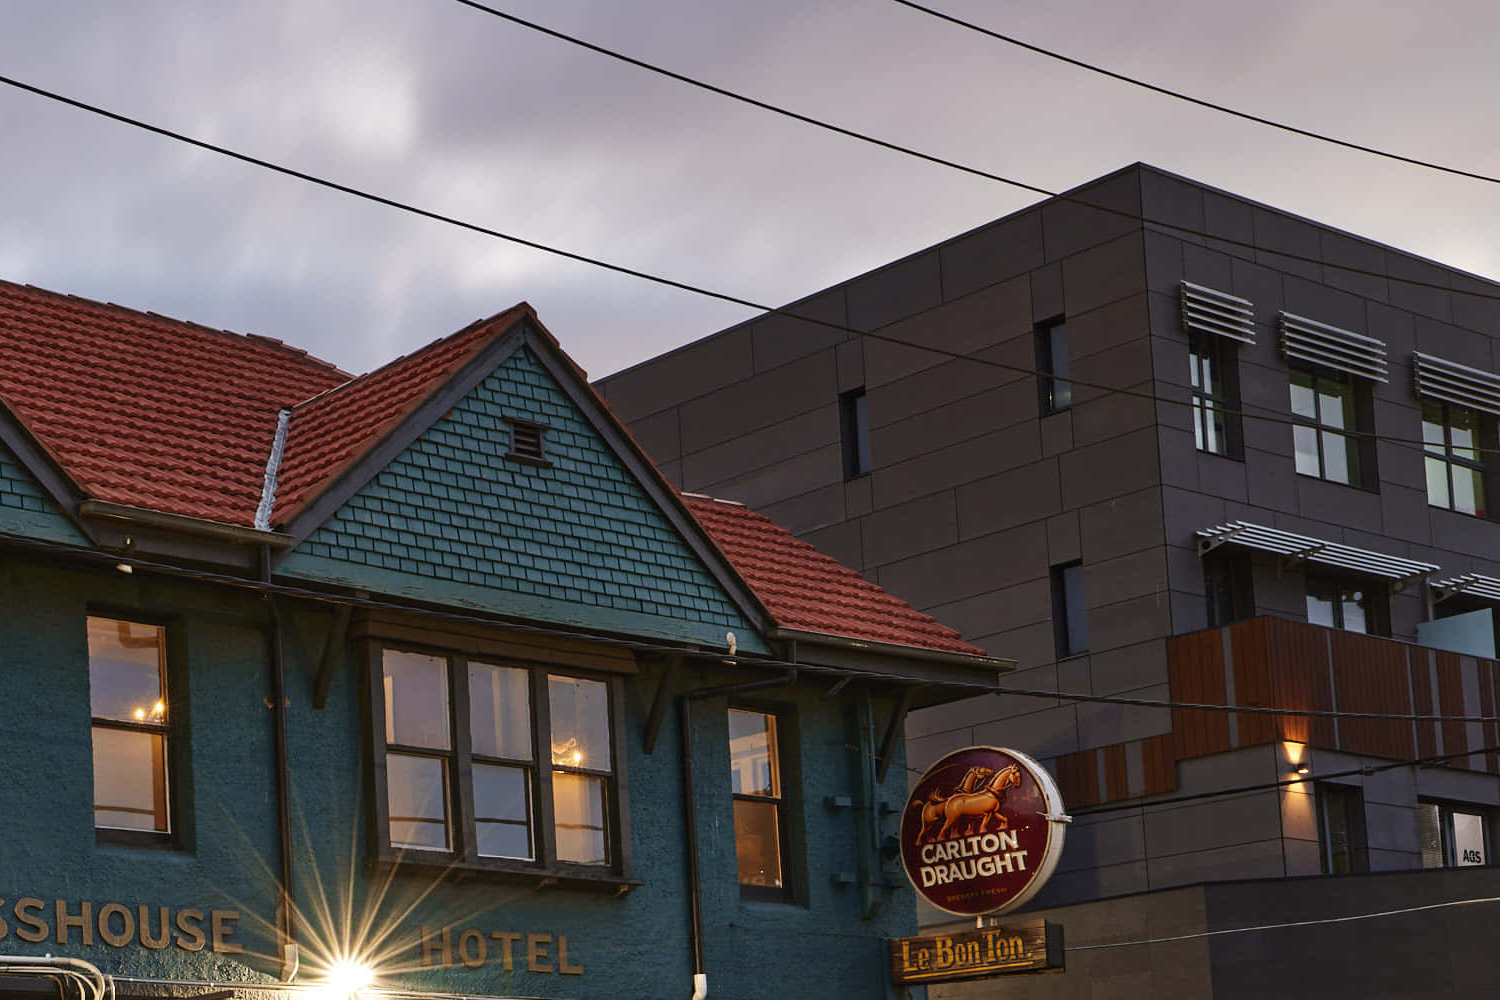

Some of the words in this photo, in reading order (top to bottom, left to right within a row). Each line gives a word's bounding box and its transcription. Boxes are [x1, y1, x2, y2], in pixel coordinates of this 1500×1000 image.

[920, 830, 1020, 864] CARLTON
[920, 851, 1028, 888] DRAUGHT
[420, 926, 584, 975] HOTEL
[901, 940, 930, 972] Le
[936, 935, 980, 967] Bon
